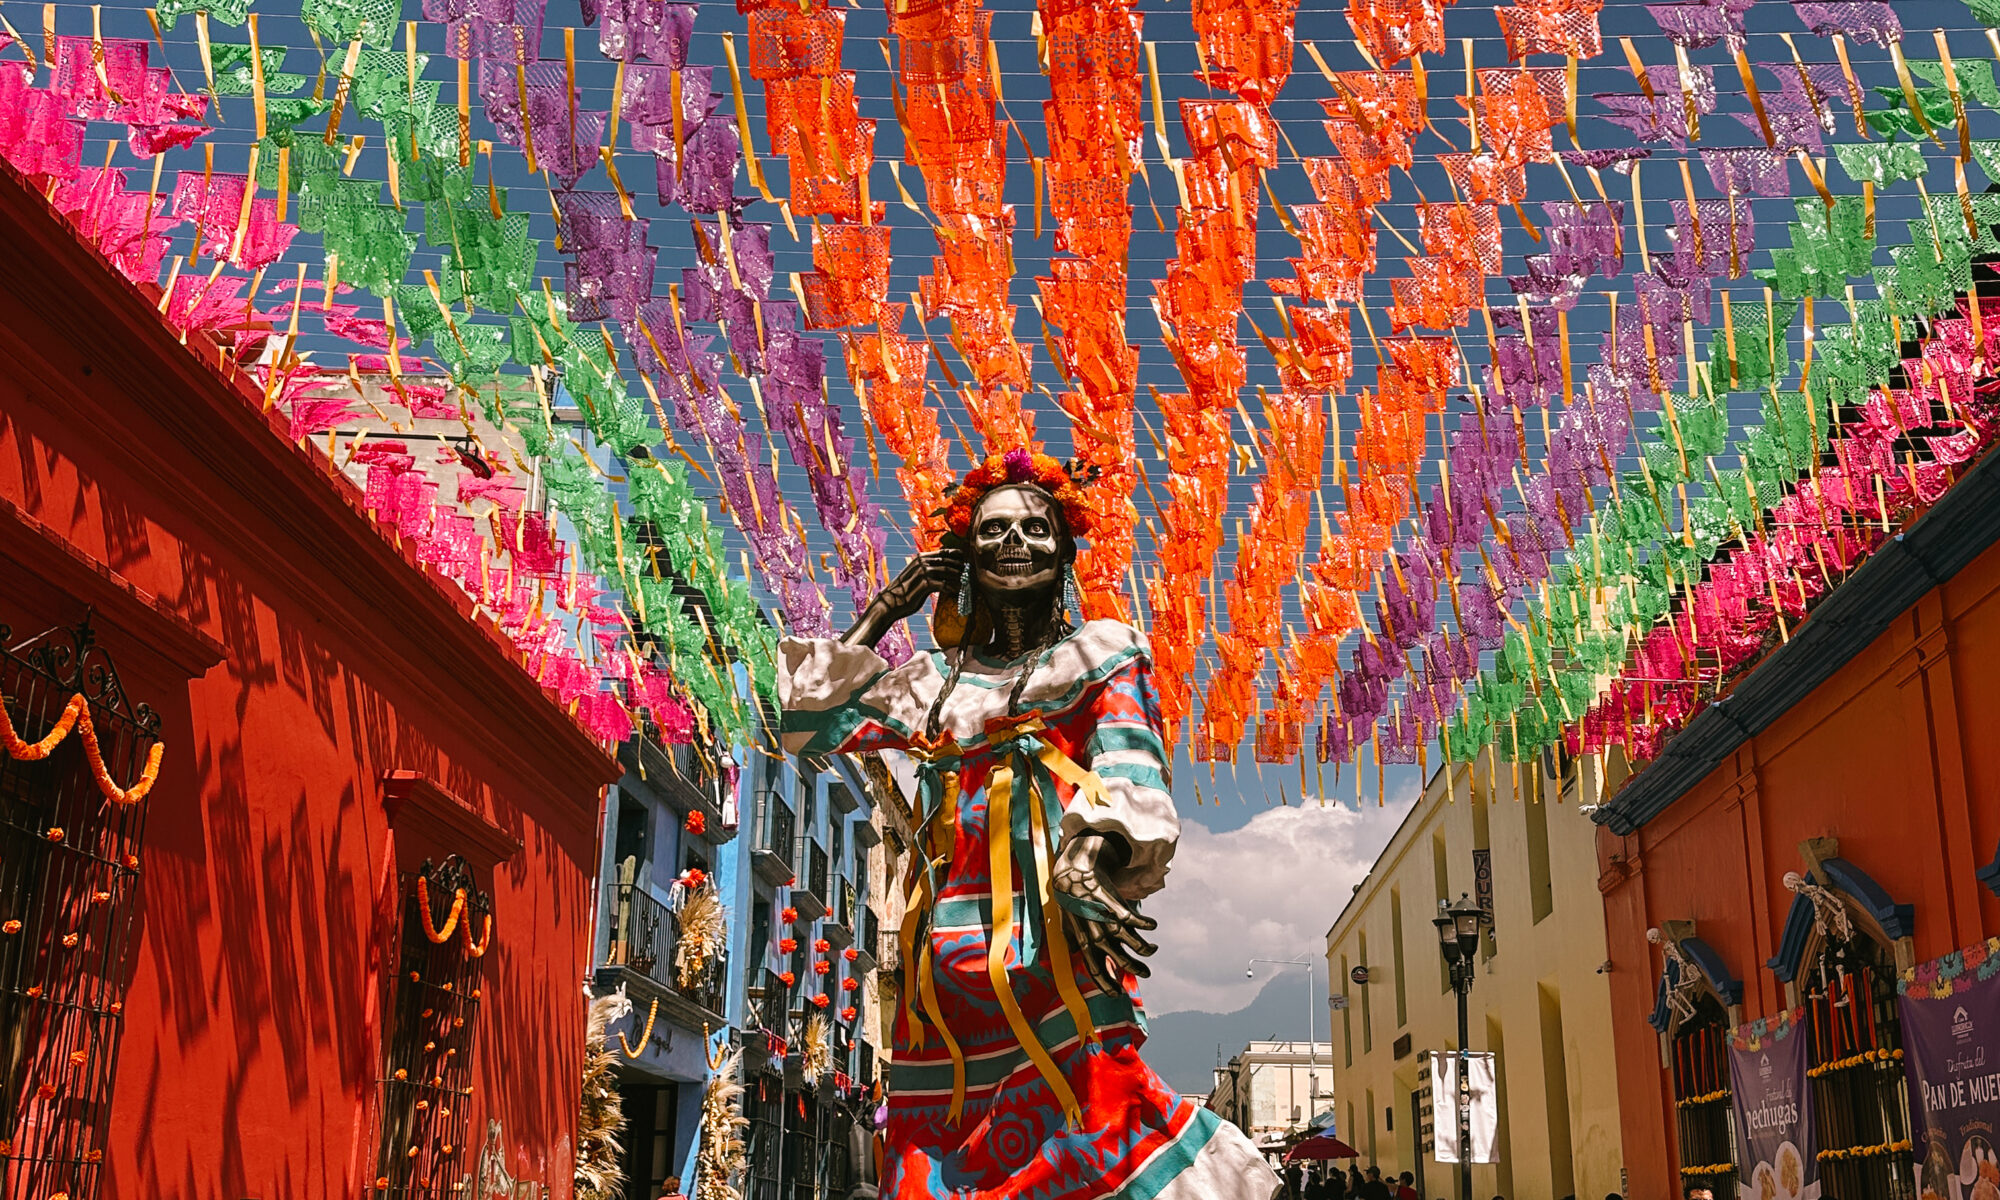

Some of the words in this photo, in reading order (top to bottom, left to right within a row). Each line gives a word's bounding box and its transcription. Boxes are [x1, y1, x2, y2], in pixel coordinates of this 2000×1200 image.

[1474, 853, 1493, 925] TOURS
[1950, 1080, 1966, 1108] DE
[1746, 1100, 1798, 1139] pechugas
